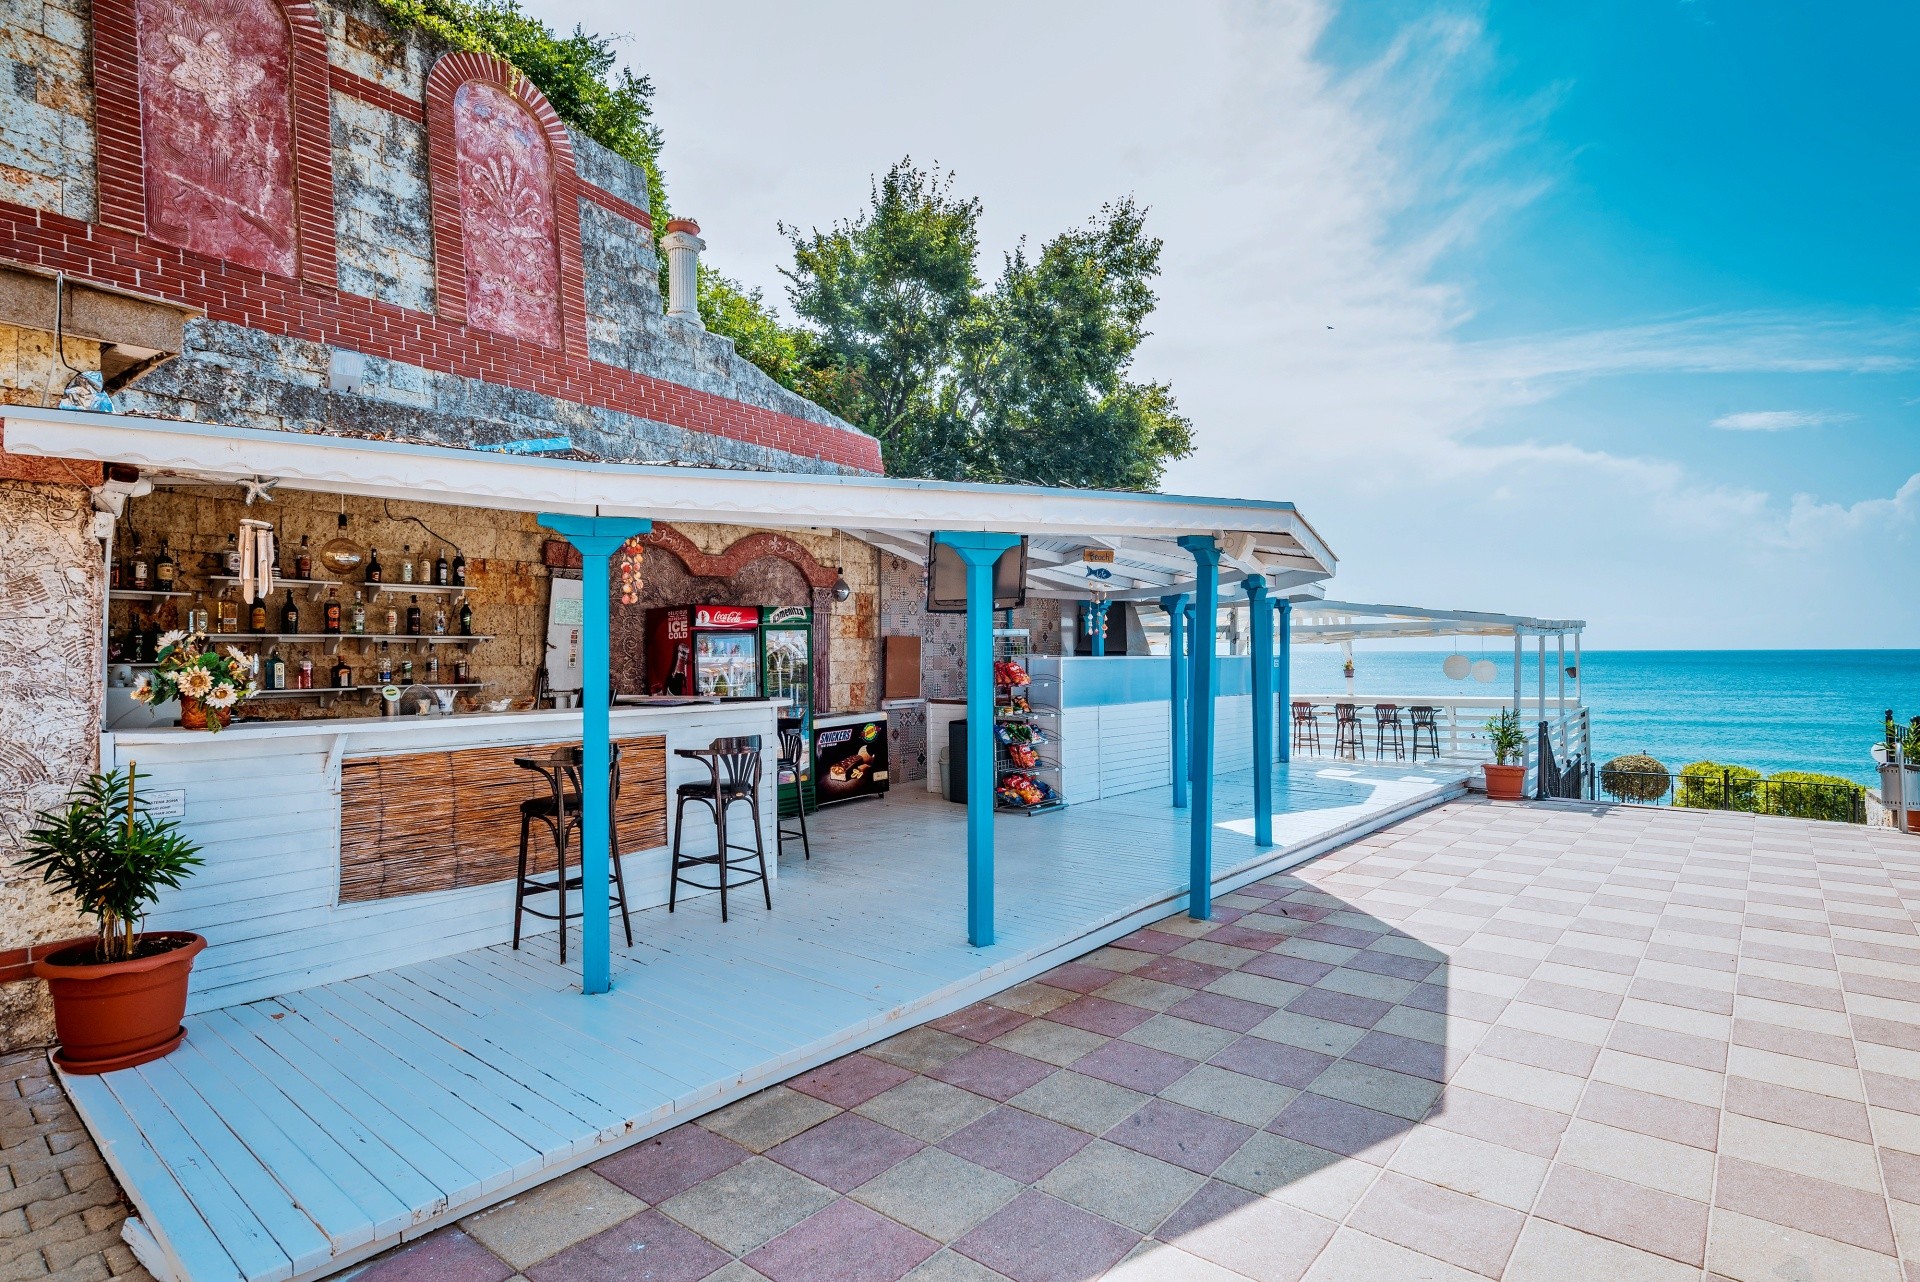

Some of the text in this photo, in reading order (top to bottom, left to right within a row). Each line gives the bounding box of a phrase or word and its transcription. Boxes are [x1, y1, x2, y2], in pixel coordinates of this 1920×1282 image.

[668, 620, 688, 633] ICE
[668, 632, 688, 640] COLD
[820, 730, 850, 744] SNICKERS
